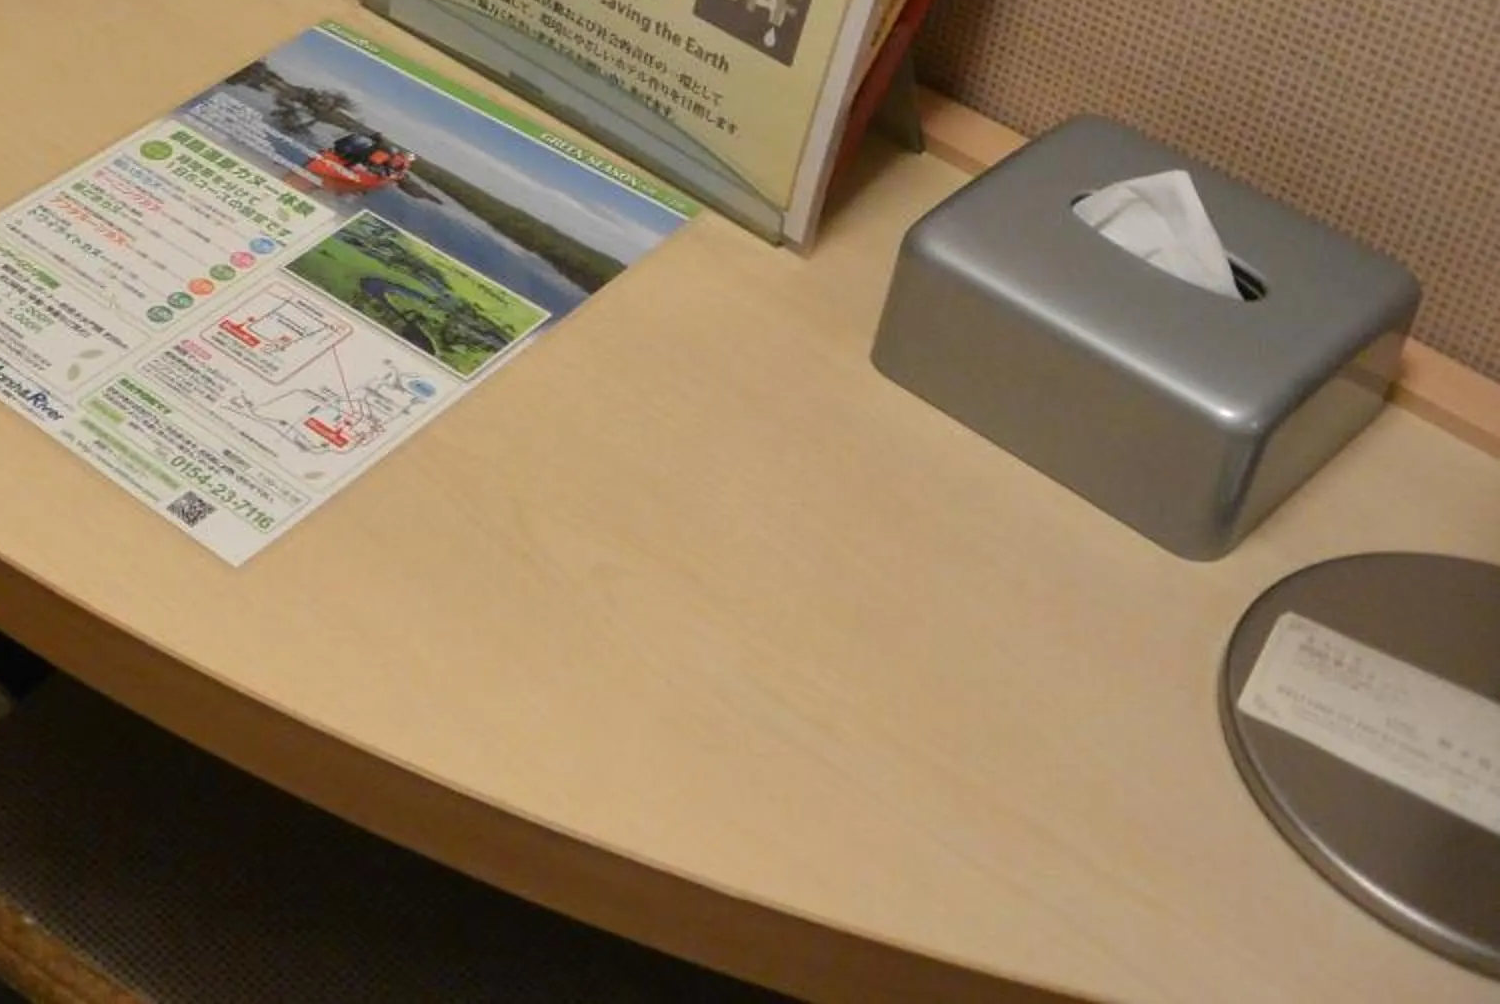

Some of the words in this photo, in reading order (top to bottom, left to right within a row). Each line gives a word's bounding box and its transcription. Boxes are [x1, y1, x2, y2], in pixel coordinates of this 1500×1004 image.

[653, 20, 684, 46] the
[685, 37, 731, 71] Earth
[170, 455, 275, 531] 0154-23-7116
